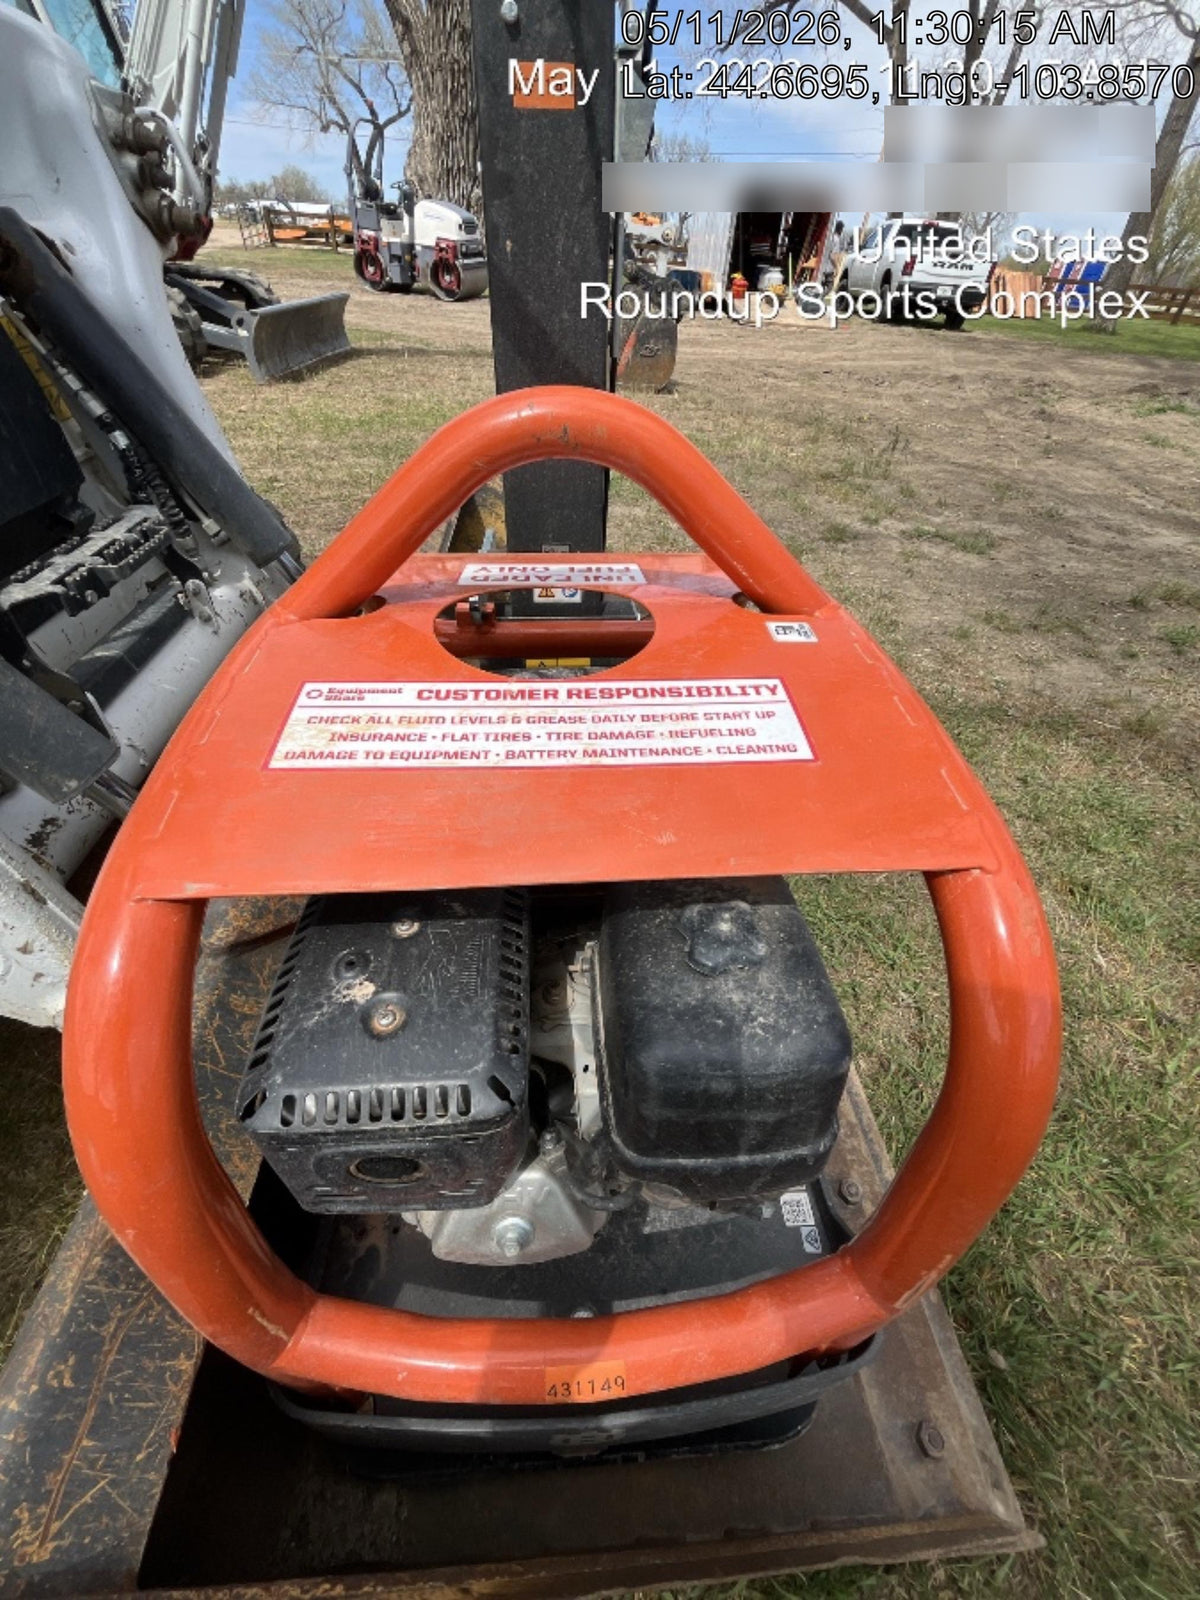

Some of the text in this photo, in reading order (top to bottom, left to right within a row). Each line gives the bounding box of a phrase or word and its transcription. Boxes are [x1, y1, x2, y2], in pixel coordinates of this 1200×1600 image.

[326, 687, 404, 695] Equipment
[416, 684, 778, 701] CUSTOMER RESPONSIBILITY
[306, 715, 362, 725] CHECK
[365, 715, 395, 725] ALL
[397, 715, 446, 725] FLUID
[450, 715, 507, 725] LEVELS
[526, 714, 588, 725] GREASE
[591, 713, 637, 723] DAILY
[640, 712, 700, 723] BEFORE
[703, 711, 751, 721] START
[755, 710, 776, 720] UP
[328, 727, 757, 743] INSURANCE FLAT TIRES TIRE DAMAGE REFUELING
[283, 743, 798, 762] DAMAGE TO EQUIPMENT BATTERY MAINTENANCE CLEANING
[546, 1375, 625, 1398] 431149
